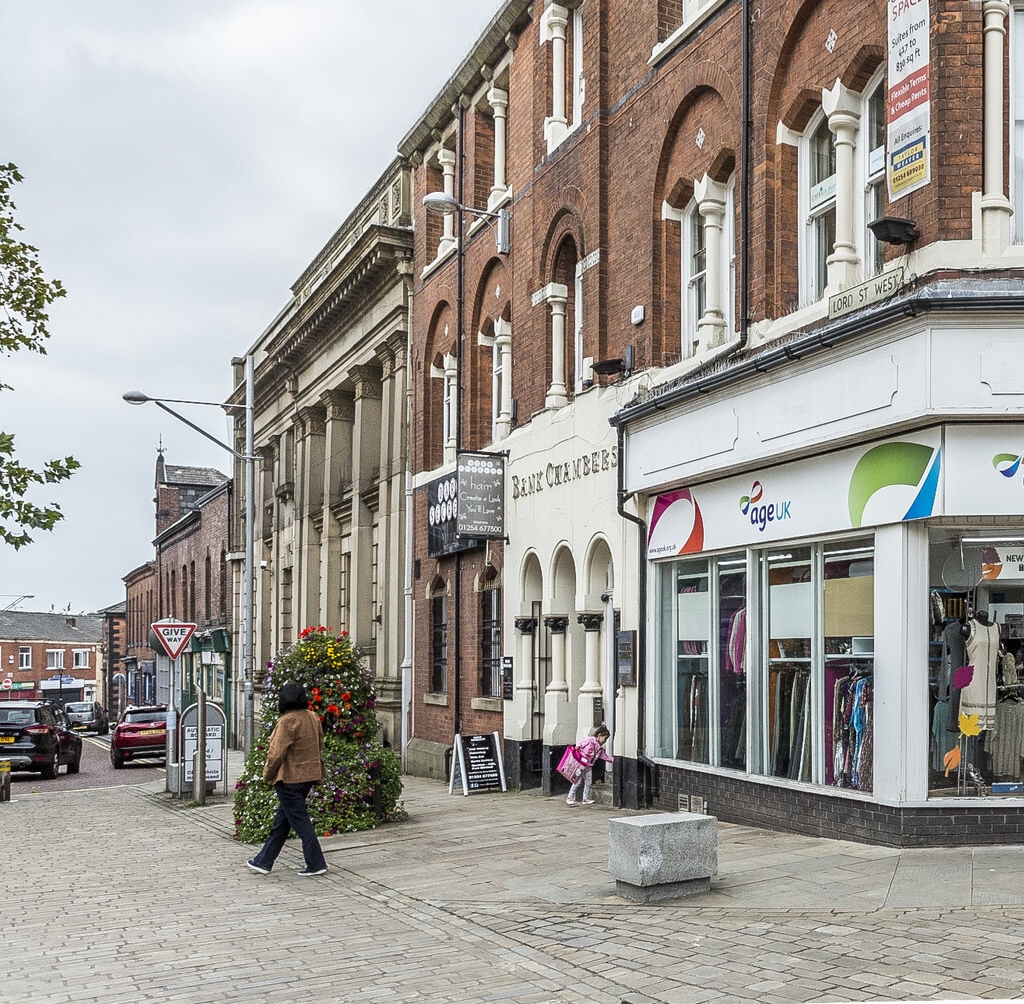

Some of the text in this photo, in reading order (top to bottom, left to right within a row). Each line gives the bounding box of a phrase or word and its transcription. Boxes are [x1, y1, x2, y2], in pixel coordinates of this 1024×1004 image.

[891, 19, 926, 49] Suites from
[909, 38, 917, 49] to
[895, 59, 906, 73] 830
[891, 73, 927, 101] Flexible Terms
[890, 87, 927, 116] & Cheap Rents
[833, 274, 900, 314] LORD ST WEST
[511, 445, 618, 500] BANK CHAMBERS
[470, 475, 492, 491] hair
[460, 491, 482, 501] Create
[488, 493, 502, 503] Look
[465, 503, 495, 514] You'll Love
[750, 501, 792, 532] age UK
[458, 524, 502, 533] 01254 677500
[649, 543, 677, 554] www.ageuk.org.uk
[1006, 554, 1024, 563] NEW
[162, 628, 187, 636] GIVE
